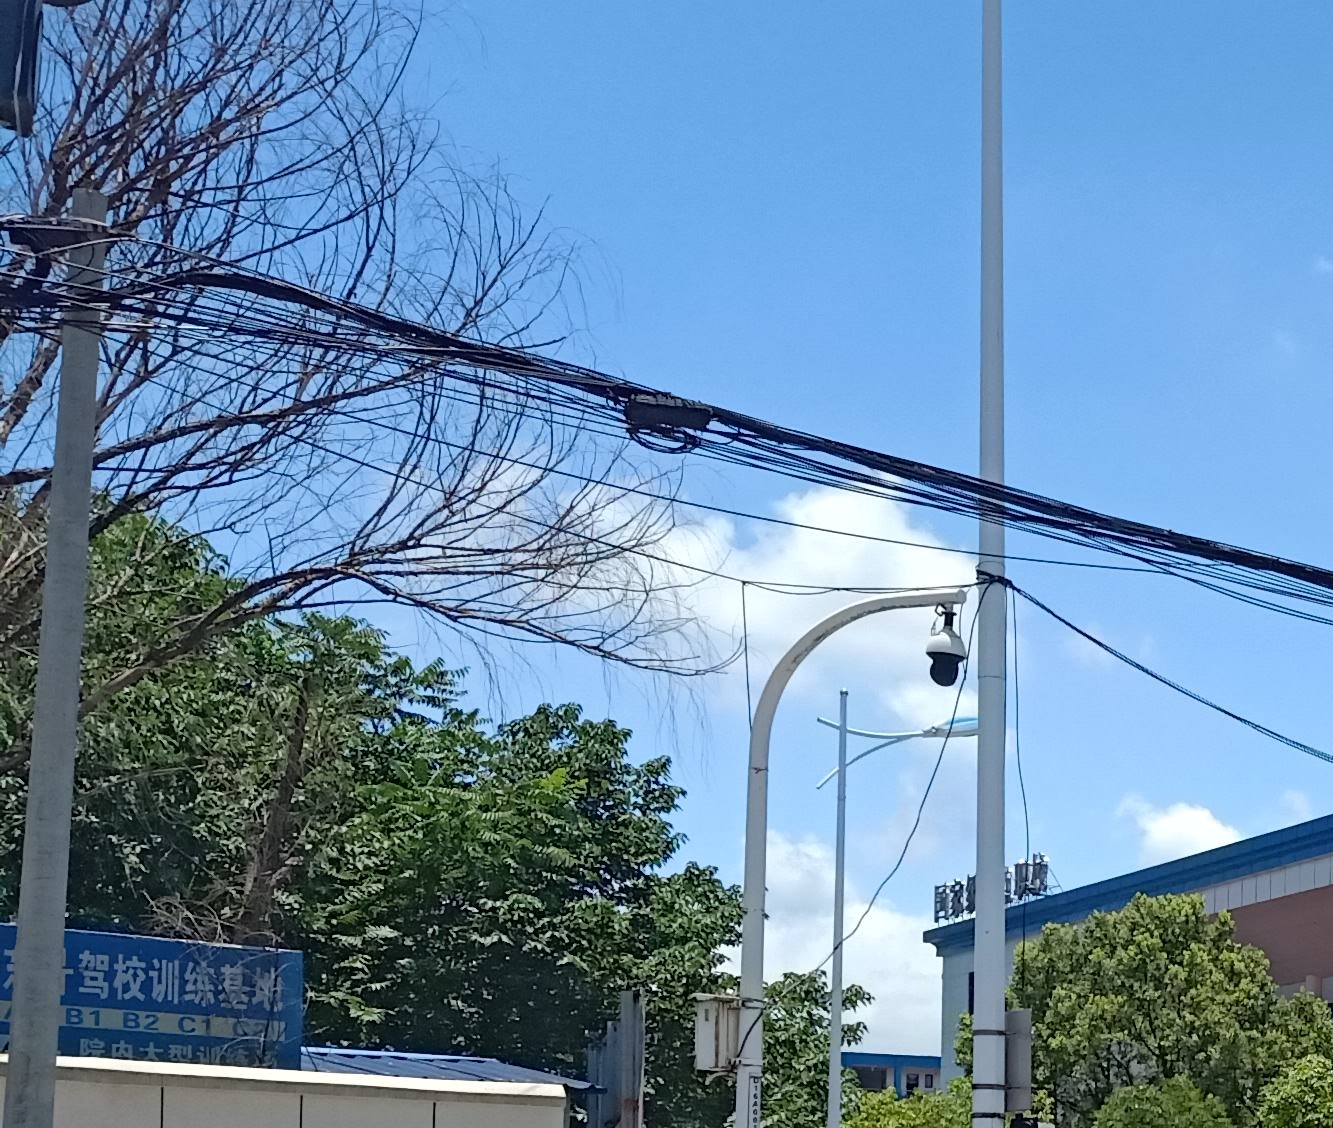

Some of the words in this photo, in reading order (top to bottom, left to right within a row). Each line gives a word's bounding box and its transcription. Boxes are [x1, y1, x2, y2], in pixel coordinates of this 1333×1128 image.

[2, 948, 284, 1013] 驾校训练基地
[66, 1007, 100, 1026] B1
[123, 1011, 160, 1031] B2
[178, 1015, 211, 1035] C1
